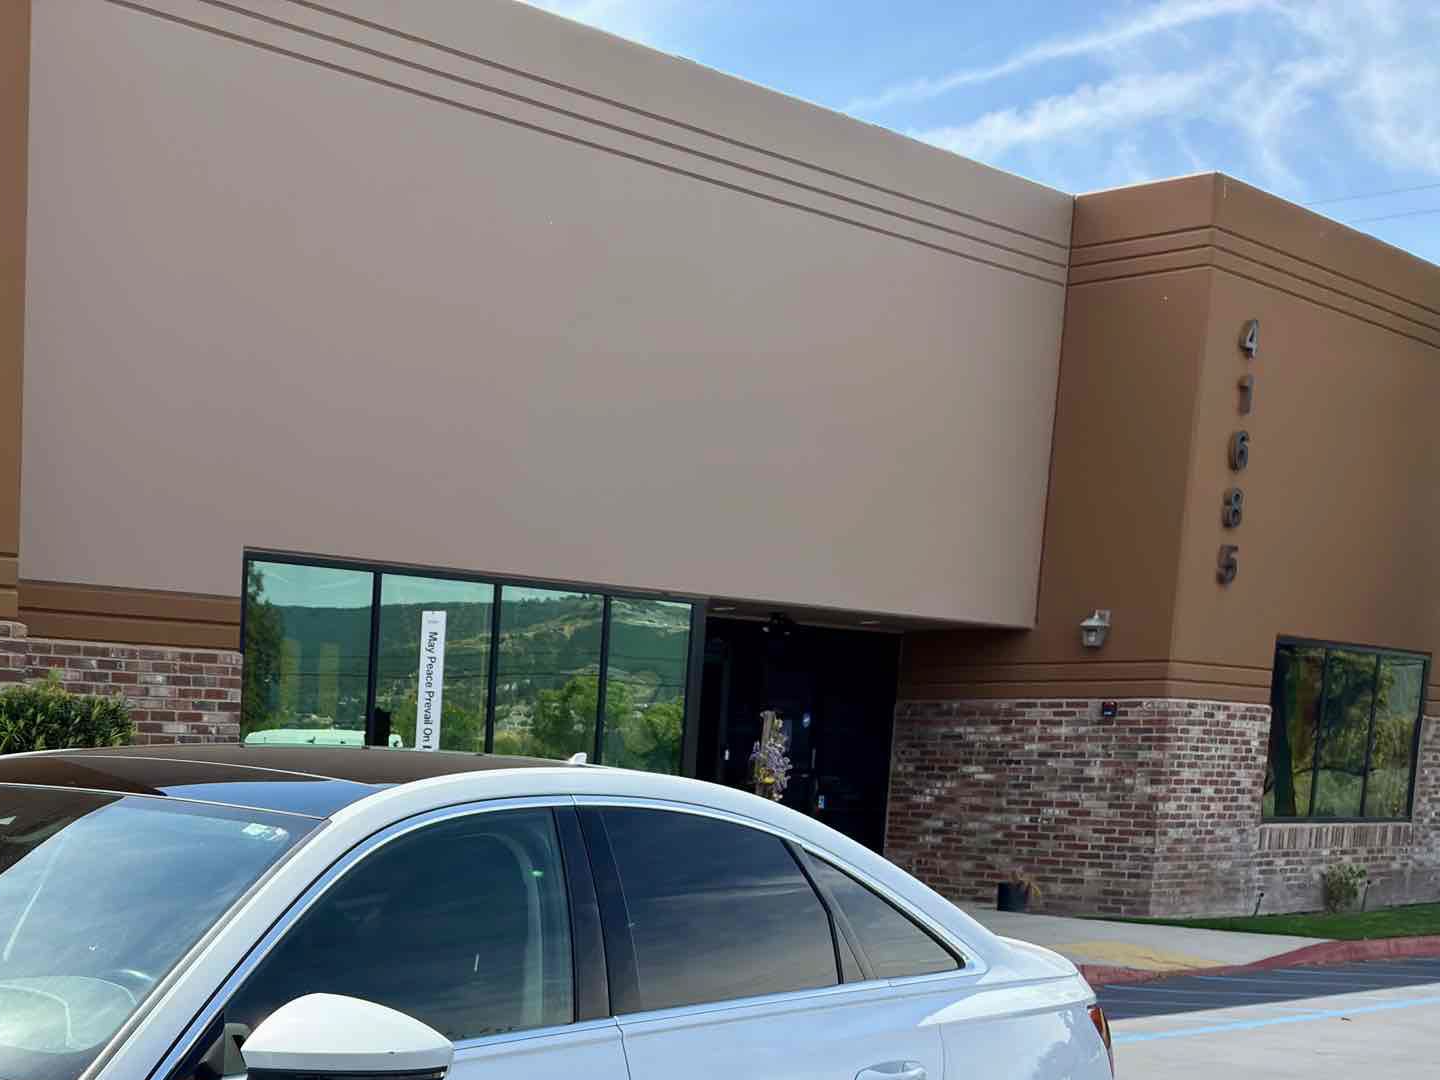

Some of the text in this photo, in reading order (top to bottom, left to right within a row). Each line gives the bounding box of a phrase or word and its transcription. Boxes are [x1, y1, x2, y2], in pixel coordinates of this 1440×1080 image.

[425, 631, 440, 655] May
[424, 656, 437, 688] Peace
[423, 690, 435, 725] Prevail
[422, 727, 433, 742] On
